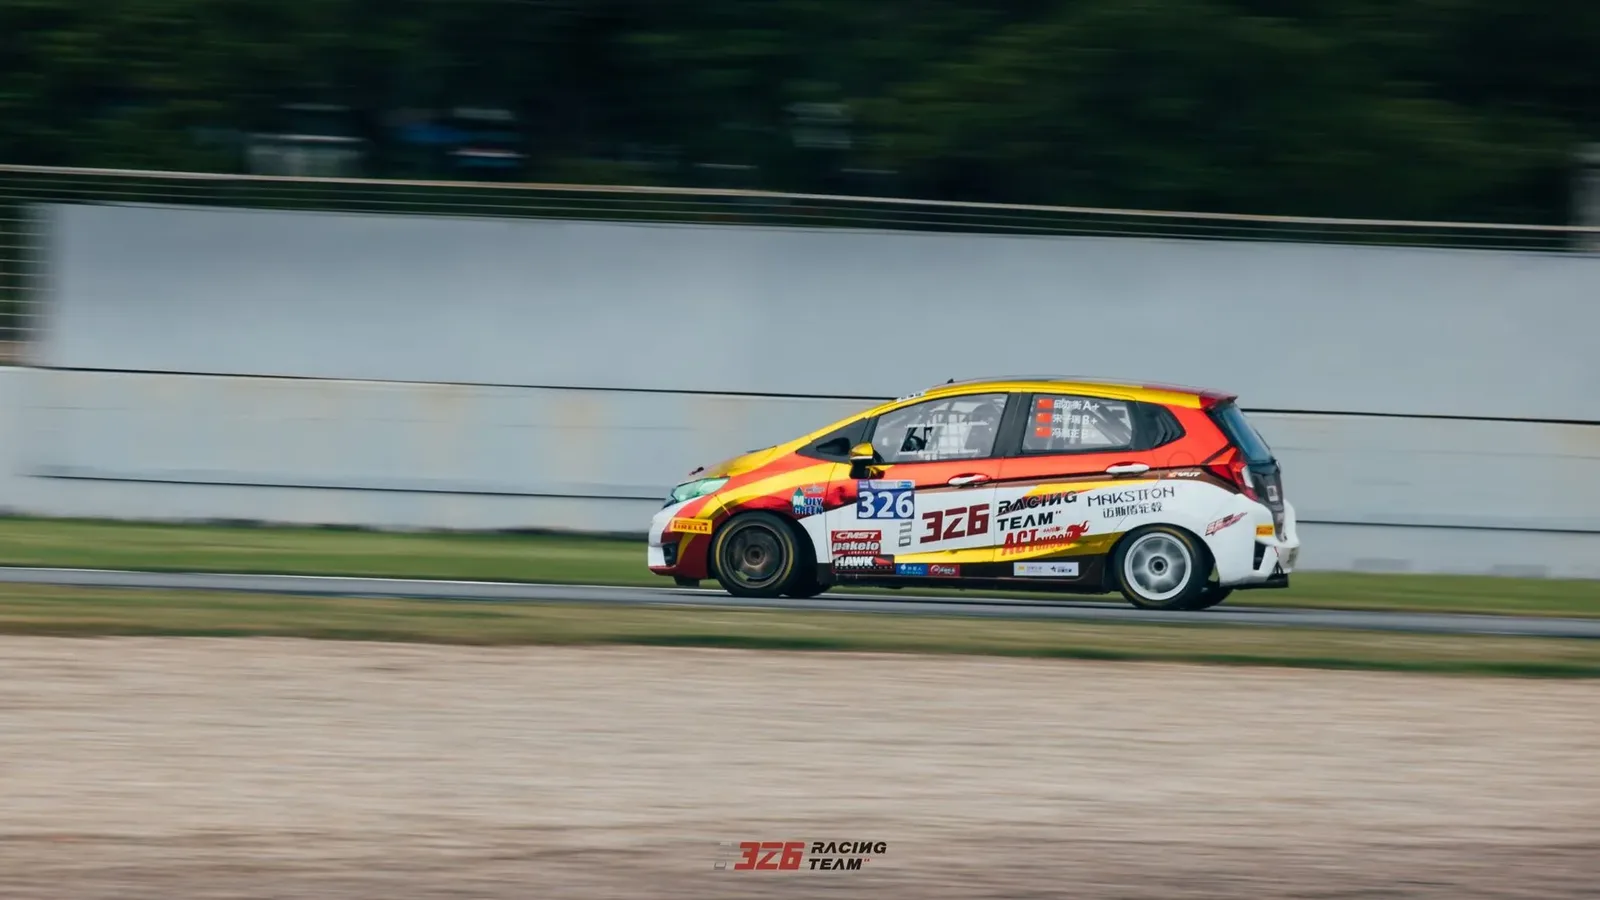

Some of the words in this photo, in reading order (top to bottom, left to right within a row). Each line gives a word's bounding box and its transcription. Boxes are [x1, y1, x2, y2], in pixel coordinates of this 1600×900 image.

[1083, 400, 1100, 411] A+
[1082, 414, 1098, 425] B+
[858, 491, 914, 518] 326
[996, 490, 1078, 515] RACING
[793, 505, 823, 515] GREEN
[673, 520, 709, 532] PIRELLI
[919, 503, 990, 544] 326
[835, 531, 879, 539] CMST
[832, 541, 880, 552] pakelo
[834, 555, 874, 567] HAWK
